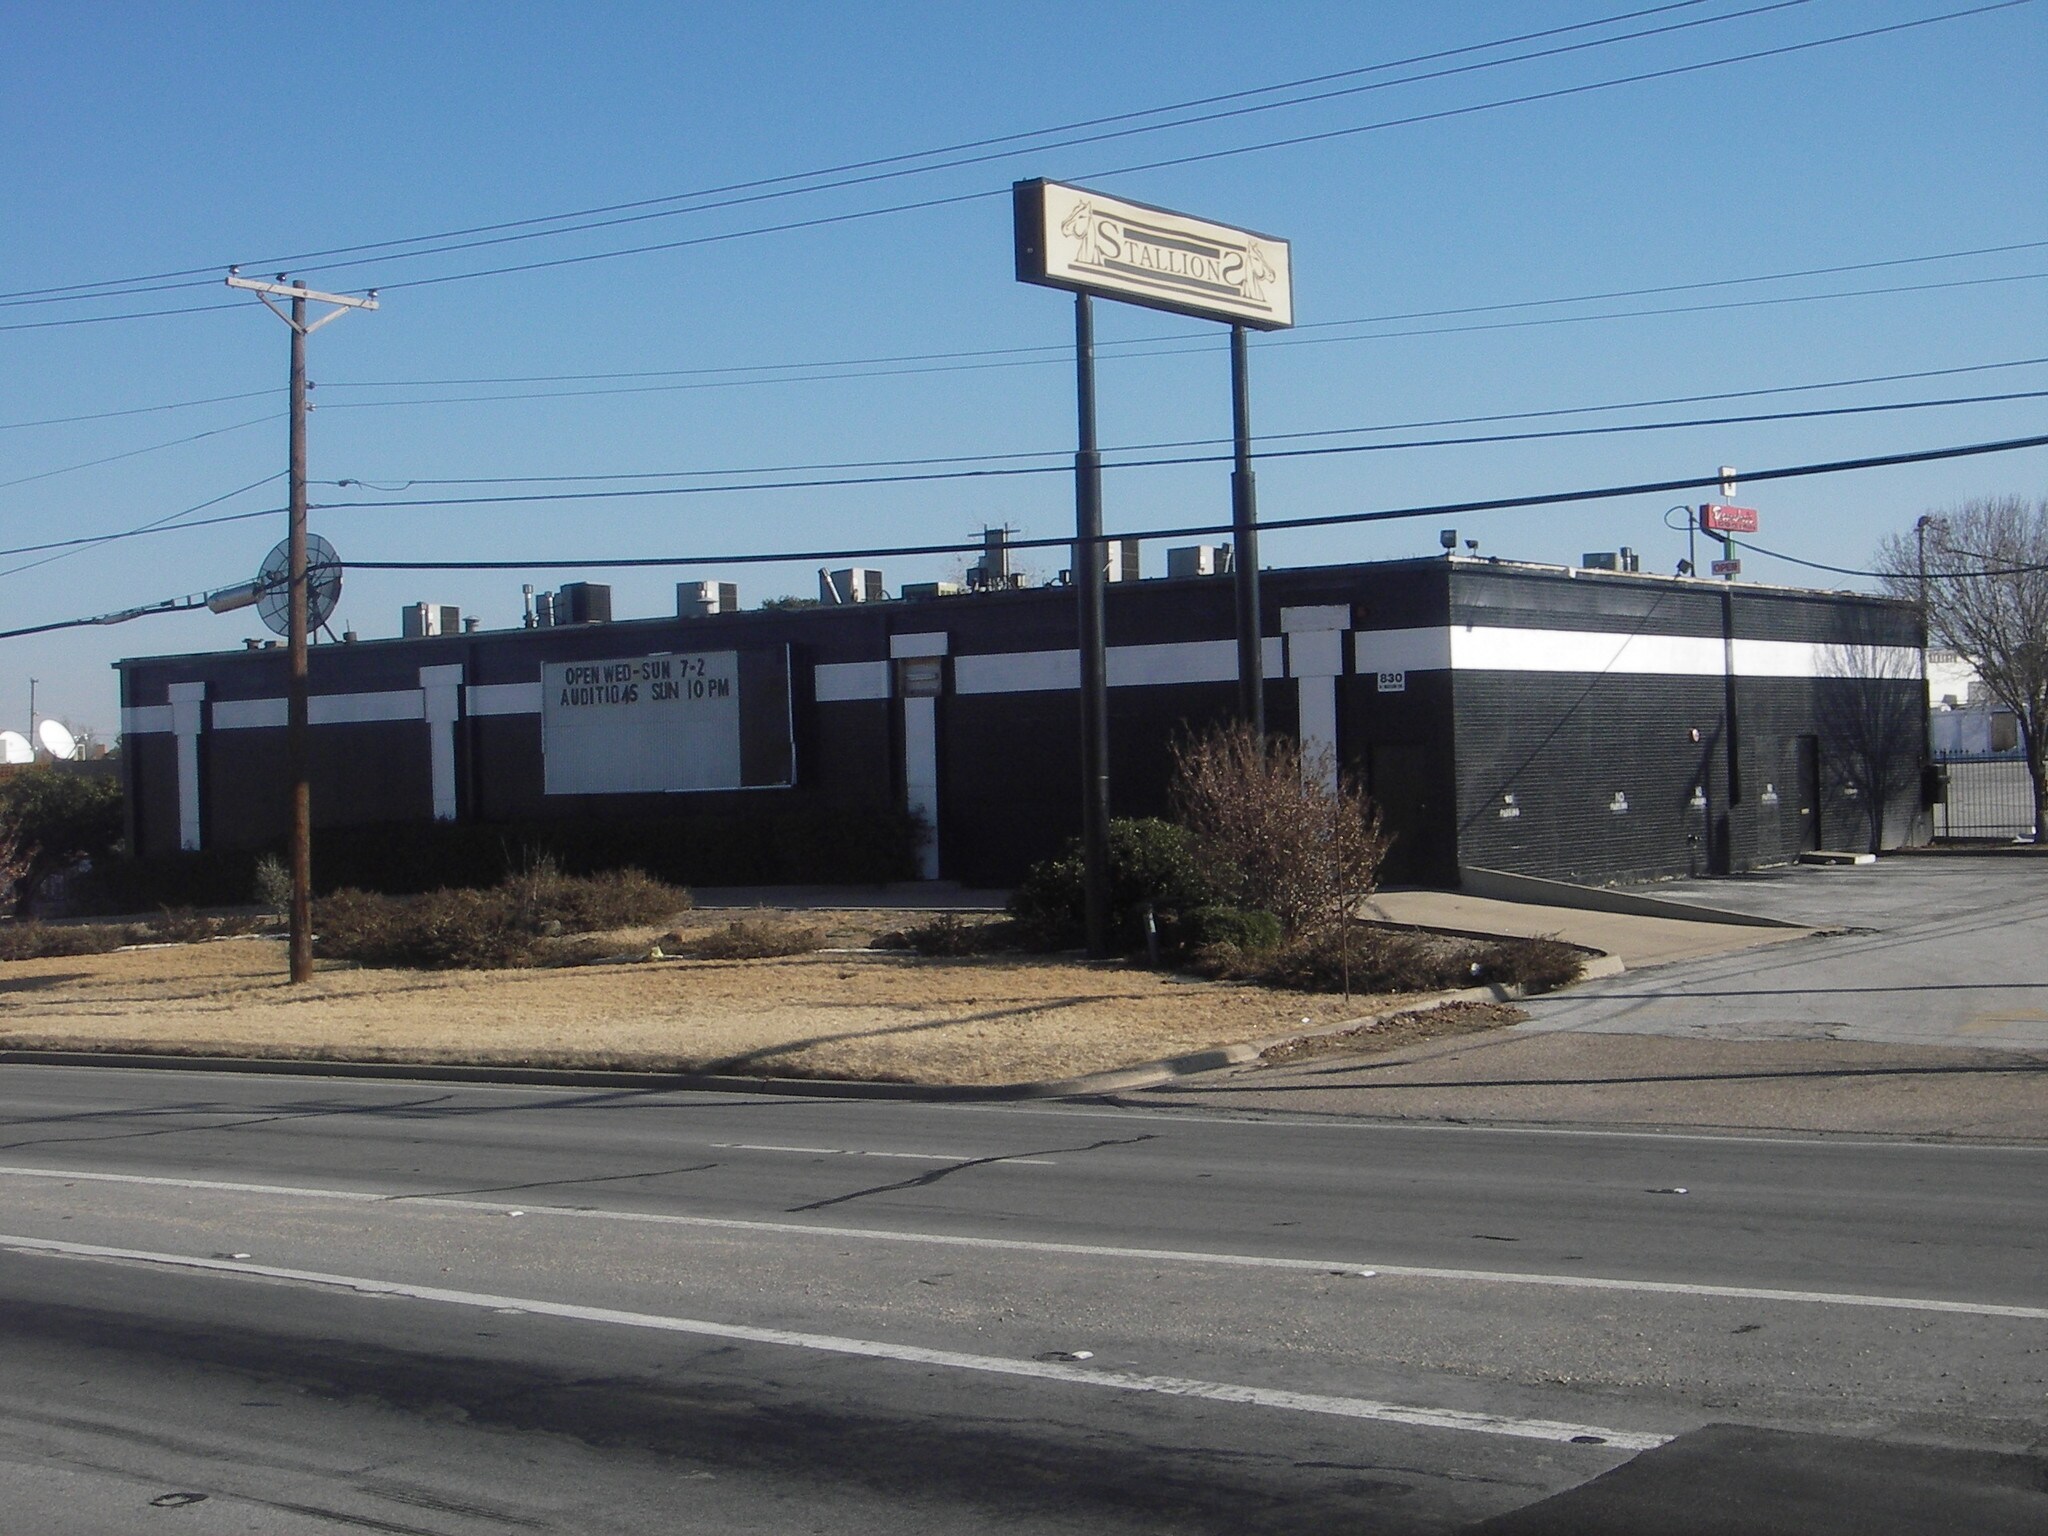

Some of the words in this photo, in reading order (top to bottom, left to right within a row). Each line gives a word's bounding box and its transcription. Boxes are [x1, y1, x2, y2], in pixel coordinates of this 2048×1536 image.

[565, 666, 600, 685] OPEN
[603, 661, 670, 682] WED-SUN
[680, 657, 705, 678] 7-2
[1380, 673, 1403, 683] 830
[652, 681, 679, 701] SUN
[688, 679, 704, 699] 10
[708, 678, 730, 698] PM
